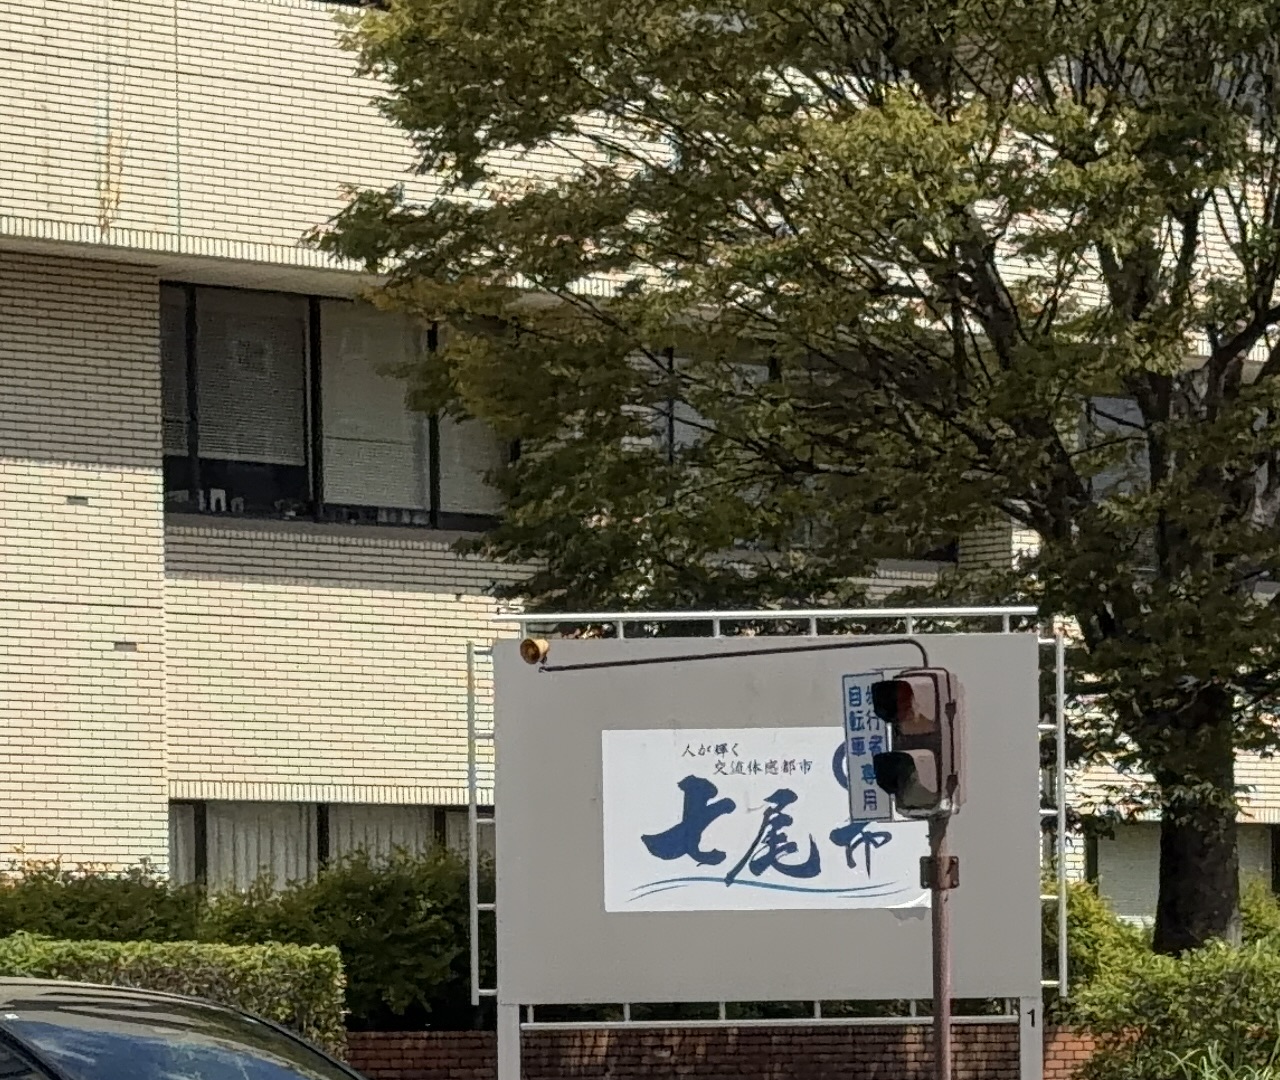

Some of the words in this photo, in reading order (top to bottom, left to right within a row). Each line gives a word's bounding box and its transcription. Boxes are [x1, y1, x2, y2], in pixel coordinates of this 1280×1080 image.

[848, 685, 866, 757] 自転車
[681, 742, 740, 759] 人が輝く
[713, 759, 813, 776] 交流体感都市
[640, 775, 894, 888] 七尾市
[1027, 1009, 1036, 1028] 1
